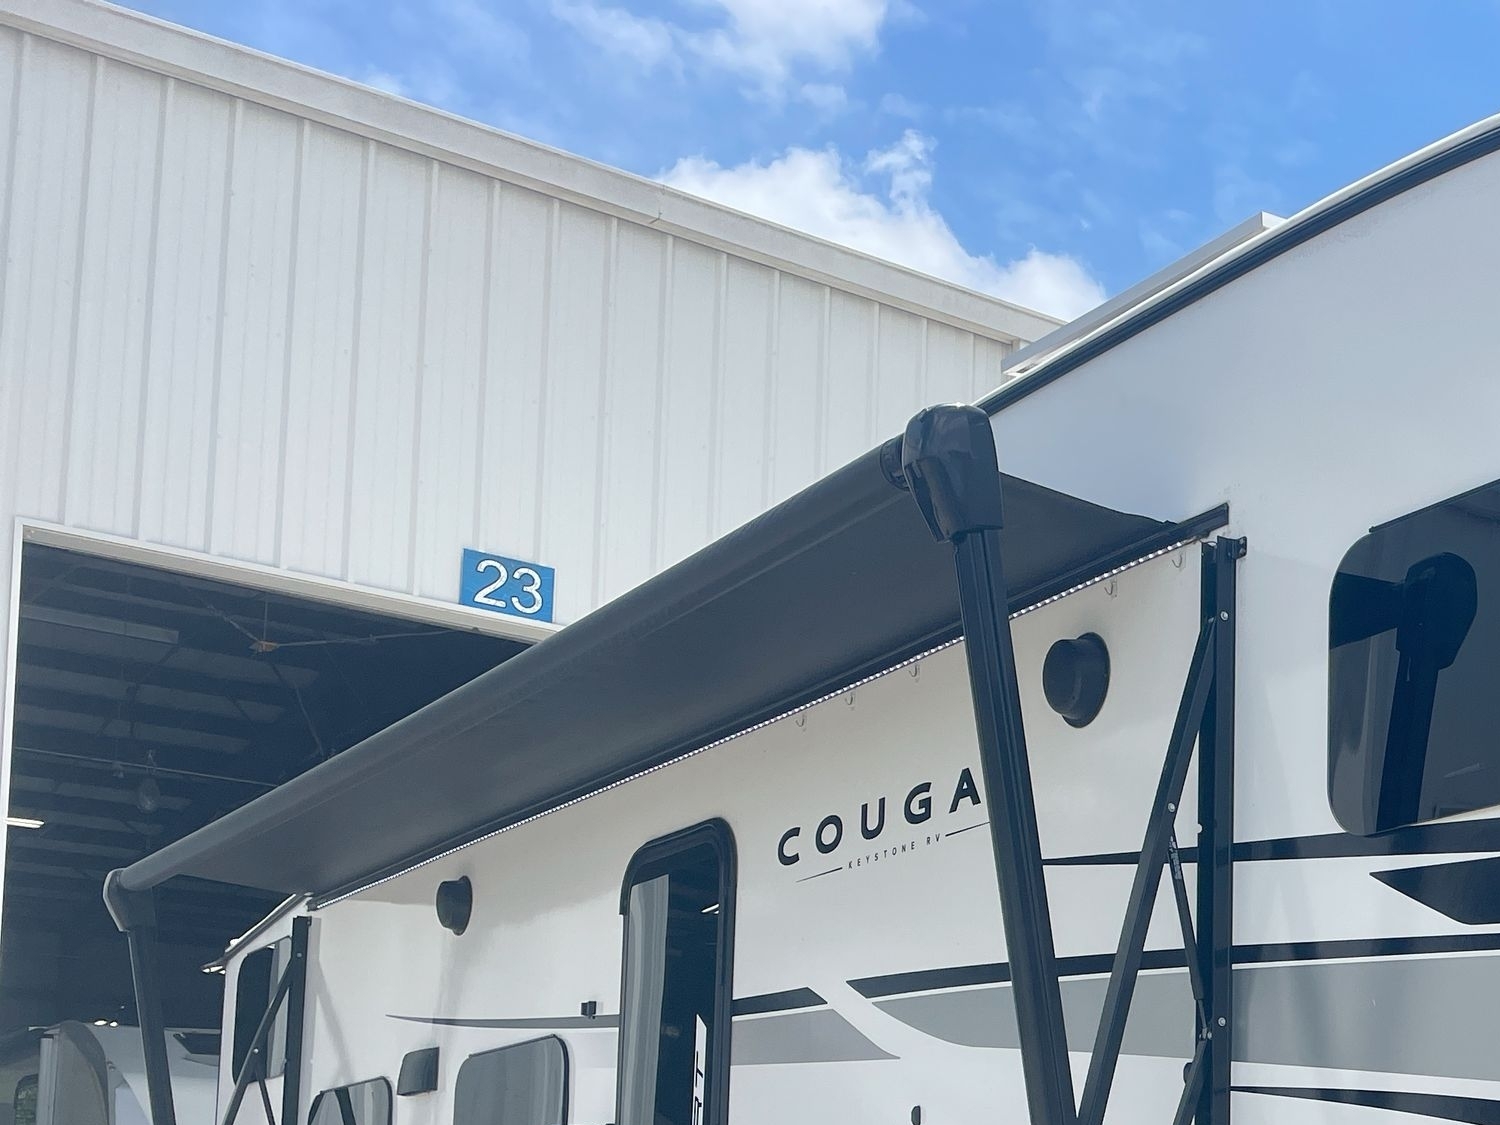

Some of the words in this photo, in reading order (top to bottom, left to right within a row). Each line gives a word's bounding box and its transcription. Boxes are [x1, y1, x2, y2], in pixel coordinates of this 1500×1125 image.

[473, 559, 543, 615] 23
[777, 767, 981, 866] COUGA
[848, 841, 915, 869] KEYSTONE
[926, 833, 940, 845] RV
